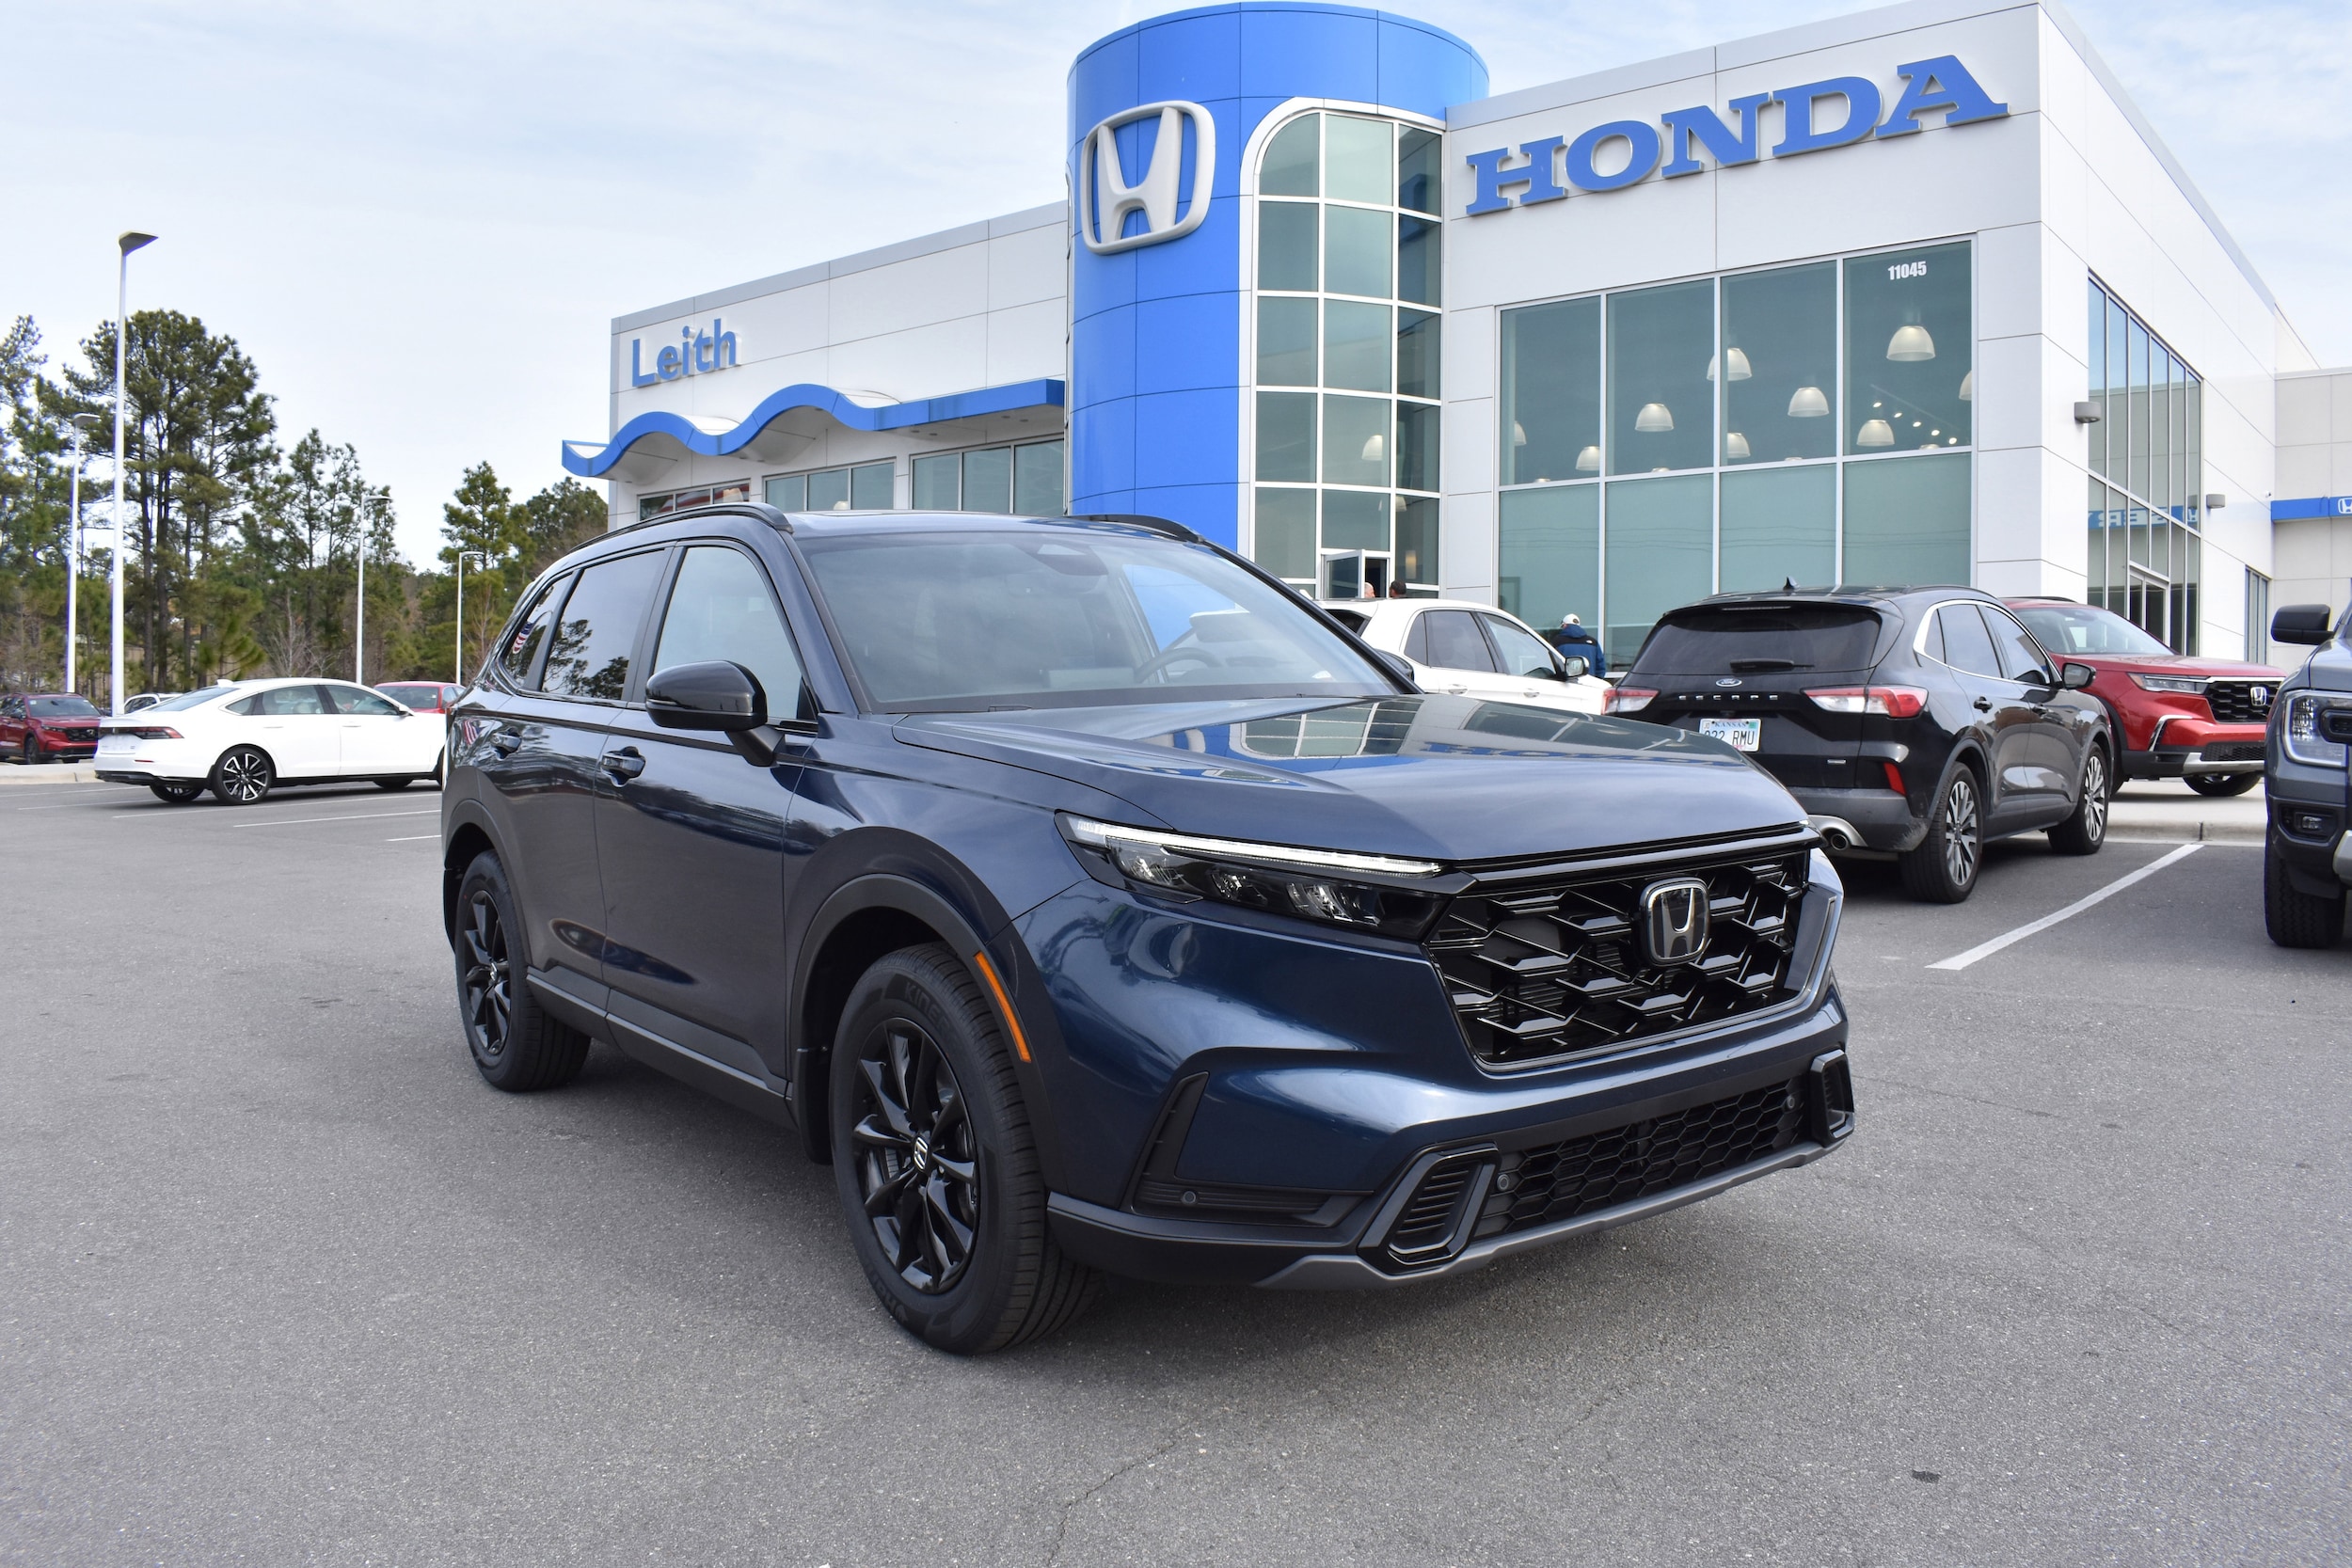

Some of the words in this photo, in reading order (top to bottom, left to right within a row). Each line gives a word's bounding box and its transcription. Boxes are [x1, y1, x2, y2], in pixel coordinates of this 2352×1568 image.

[1466, 54, 2009, 215] HONDA
[1887, 261, 1928, 280] 11045
[631, 317, 739, 388] Leith
[1732, 730, 1755, 745] RMU
